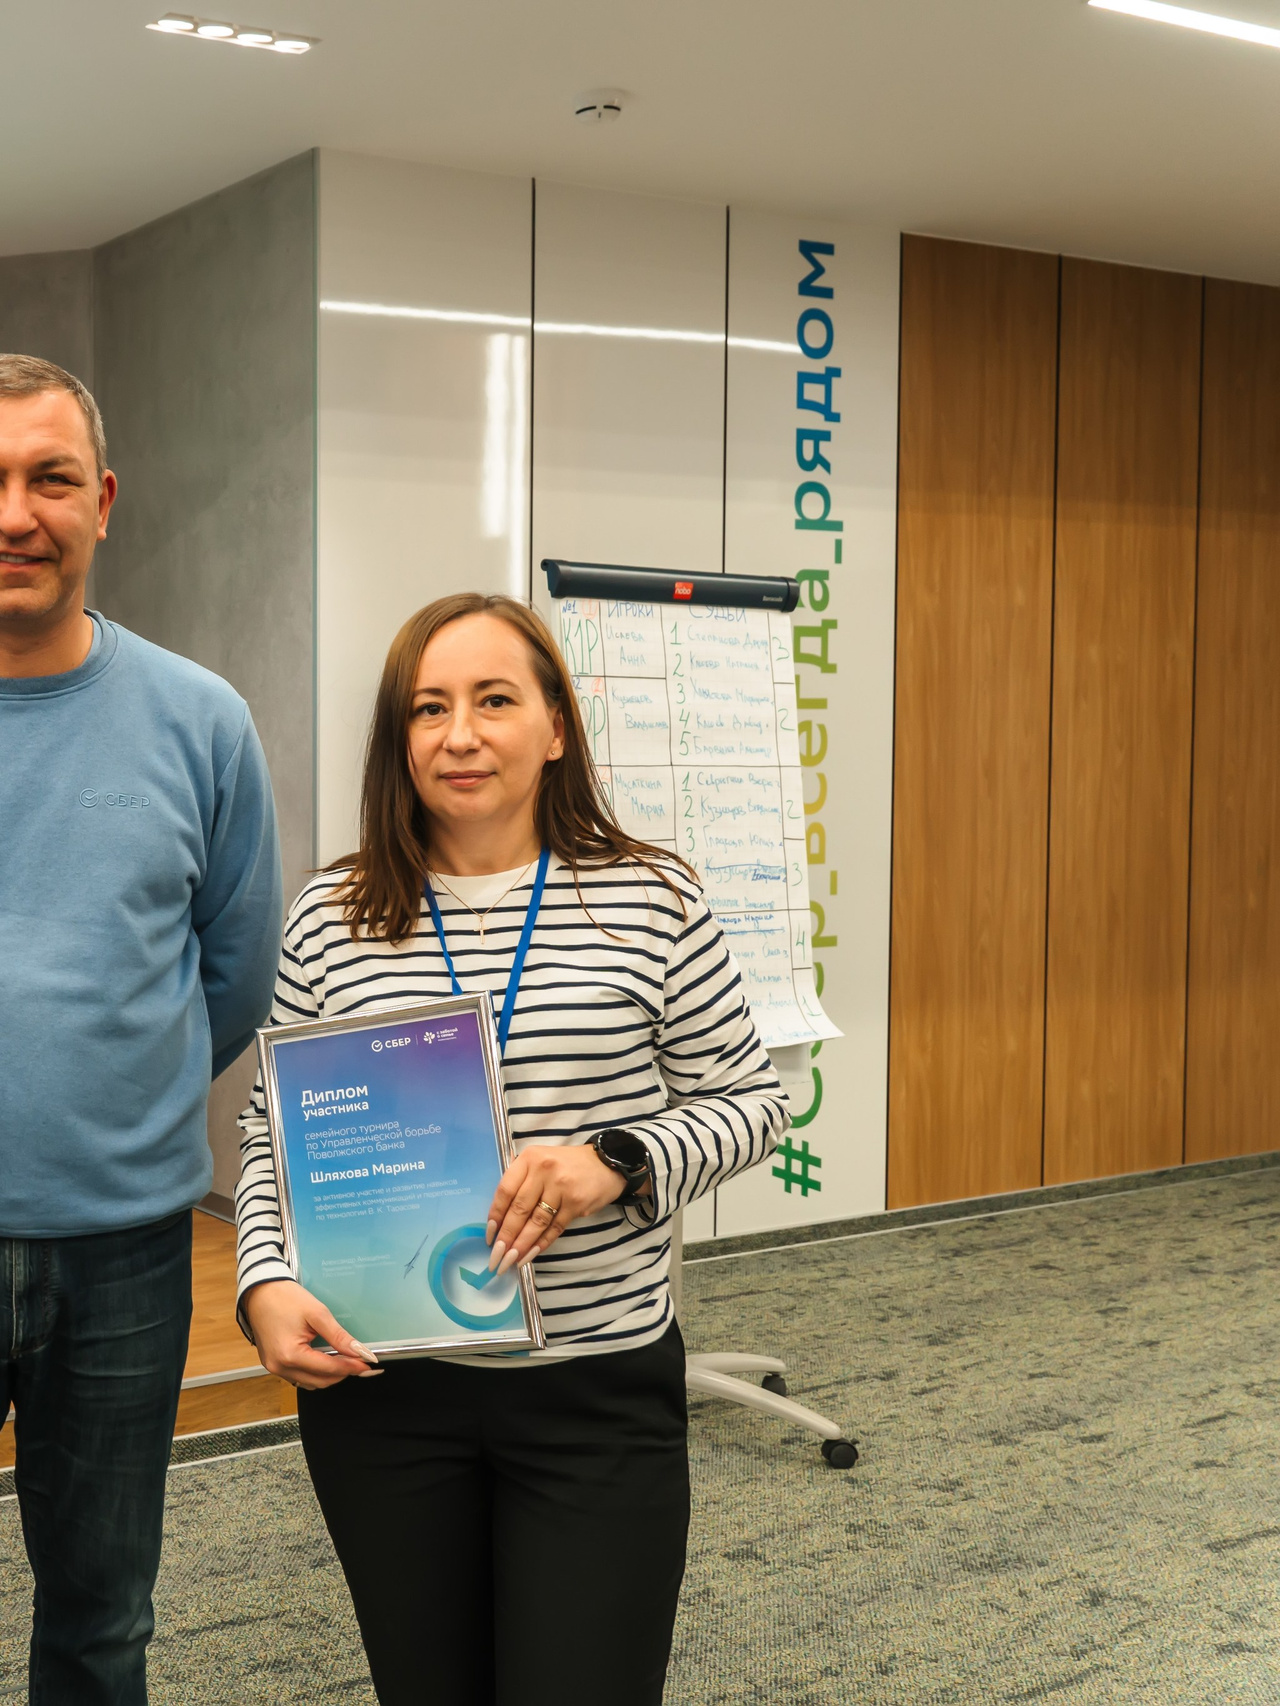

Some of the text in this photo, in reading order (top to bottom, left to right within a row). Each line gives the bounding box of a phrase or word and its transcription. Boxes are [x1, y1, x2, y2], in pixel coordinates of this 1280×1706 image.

[674, 586, 692, 595] nobo
[606, 600, 654, 618] ИГРОКИ
[619, 645, 647, 666] Анна
[772, 636, 790, 661] 3
[777, 708, 796, 731] 2
[105, 792, 150, 808] СБЕР
[631, 796, 665, 821] Мария
[786, 800, 801, 820] 2
[791, 862, 803, 887] 3
[385, 1037, 411, 1048] СБЕР
[301, 1085, 368, 1107] Диплом
[303, 1101, 369, 1121] участника
[304, 1120, 400, 1141] семейного турнира
[306, 1123, 442, 1151] по Управленческой борьбе
[307, 1140, 406, 1160] Поволжского банка
[310, 1160, 426, 1184] Шляхова Марина
